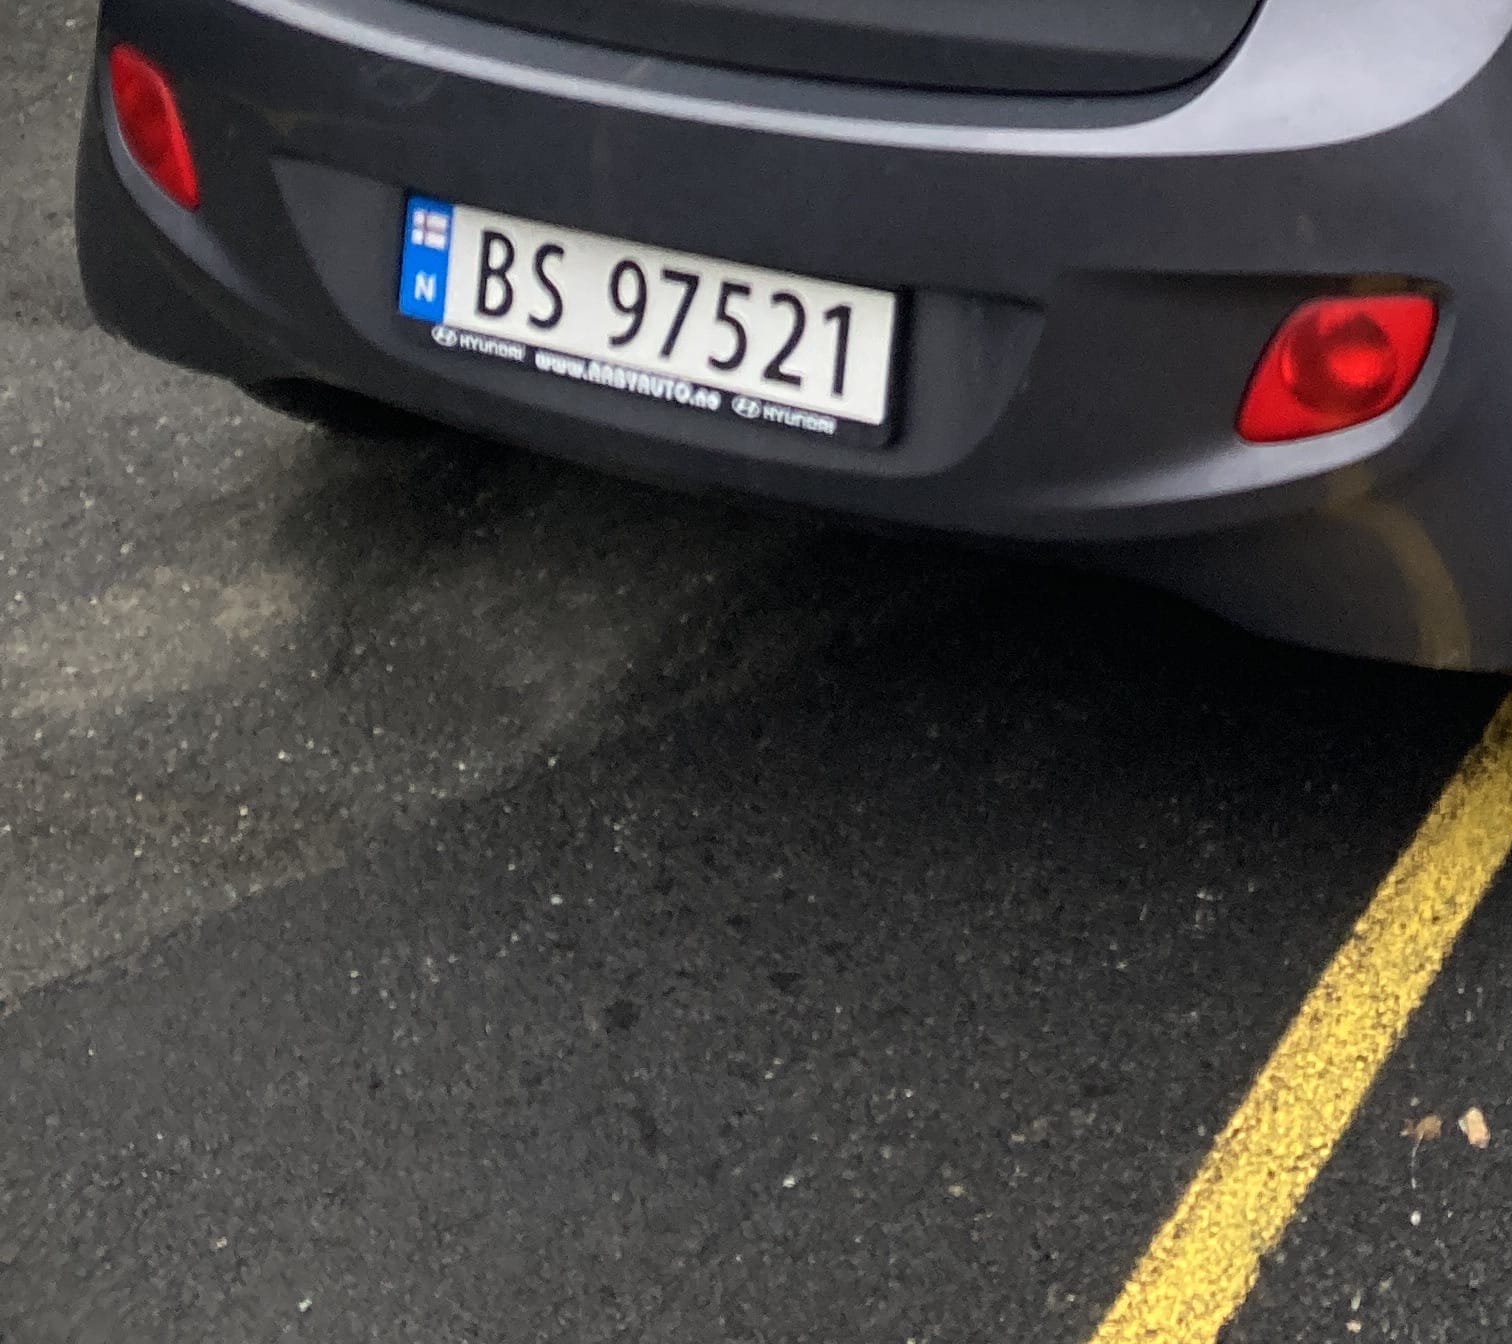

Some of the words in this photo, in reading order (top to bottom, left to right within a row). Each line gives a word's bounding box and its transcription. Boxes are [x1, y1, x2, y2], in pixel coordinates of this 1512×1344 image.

[414, 270, 437, 303] N
[475, 228, 566, 331] BS
[607, 259, 854, 397] 97521
[459, 334, 525, 362] HYUNDAI
